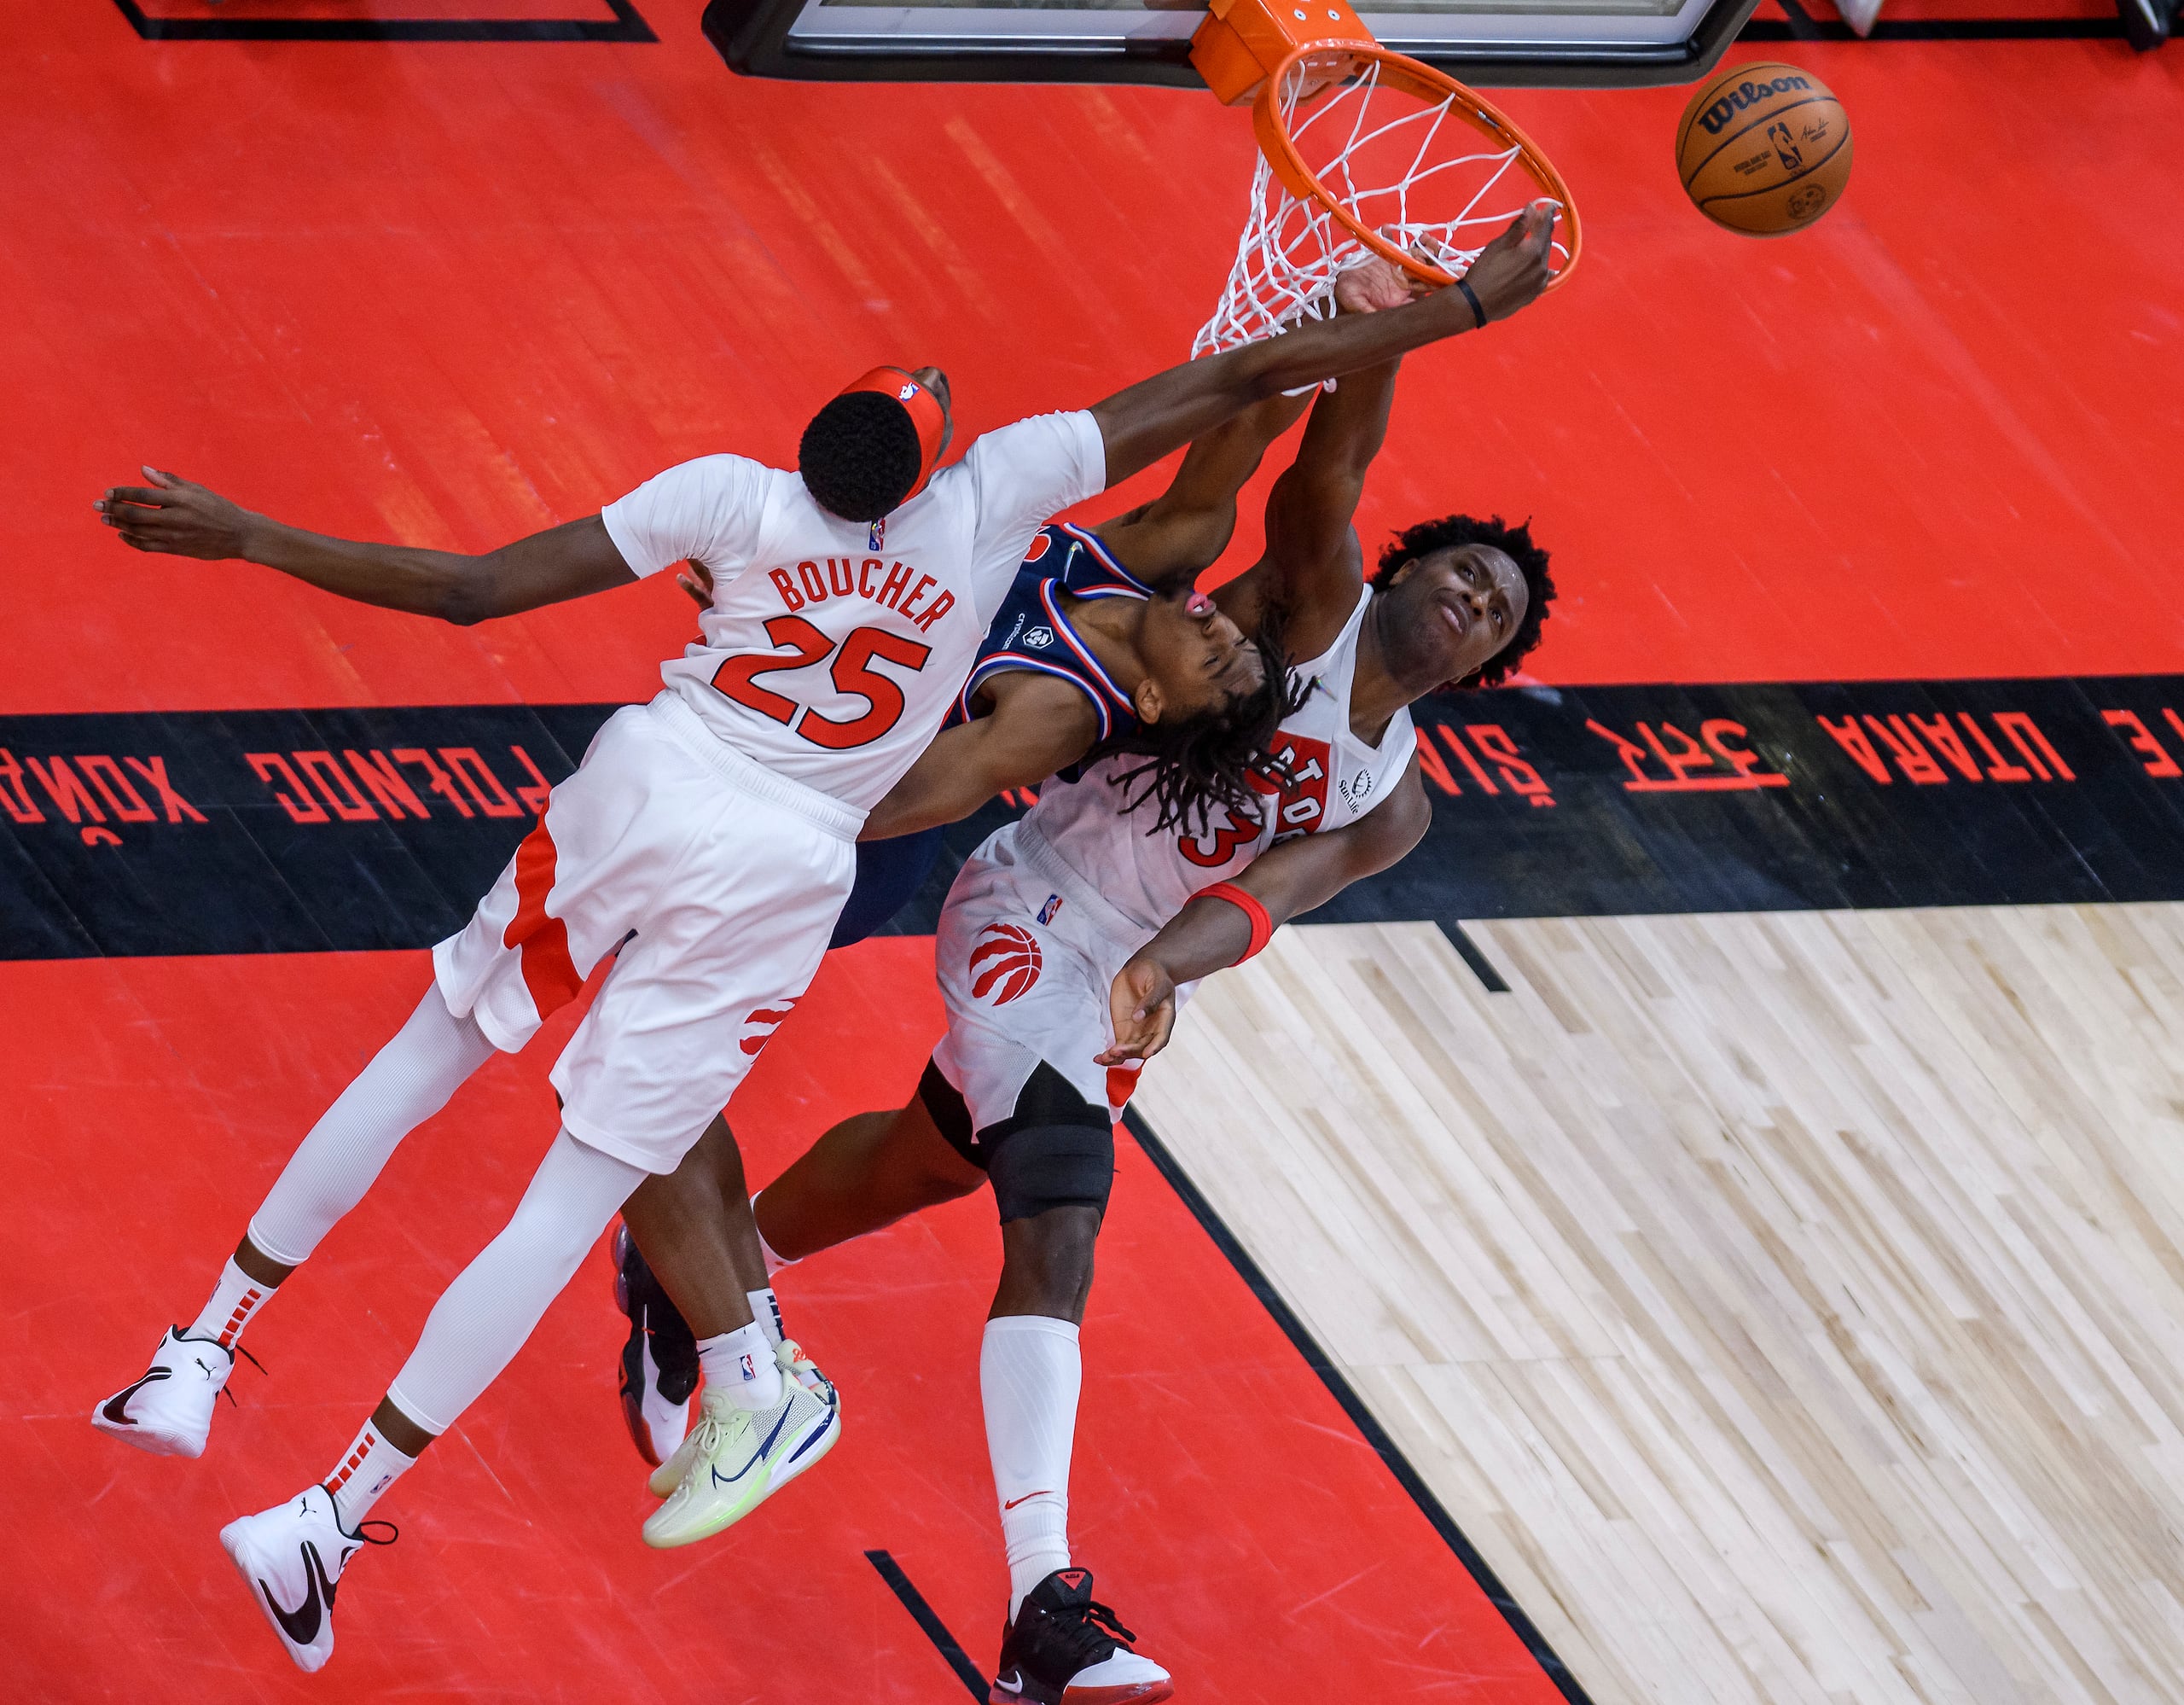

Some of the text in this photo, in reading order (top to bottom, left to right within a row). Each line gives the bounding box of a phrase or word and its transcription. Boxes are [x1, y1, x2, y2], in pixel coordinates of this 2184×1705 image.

[1698, 77, 1812, 134] Wilson
[769, 558, 956, 633] BOUCHER
[711, 614, 933, 749] 25
[1415, 724, 1557, 808] ŠIA
[1586, 718, 1790, 792] उत्तर
[1816, 712, 2077, 785] UTARA
[1177, 811, 1262, 868] 3
